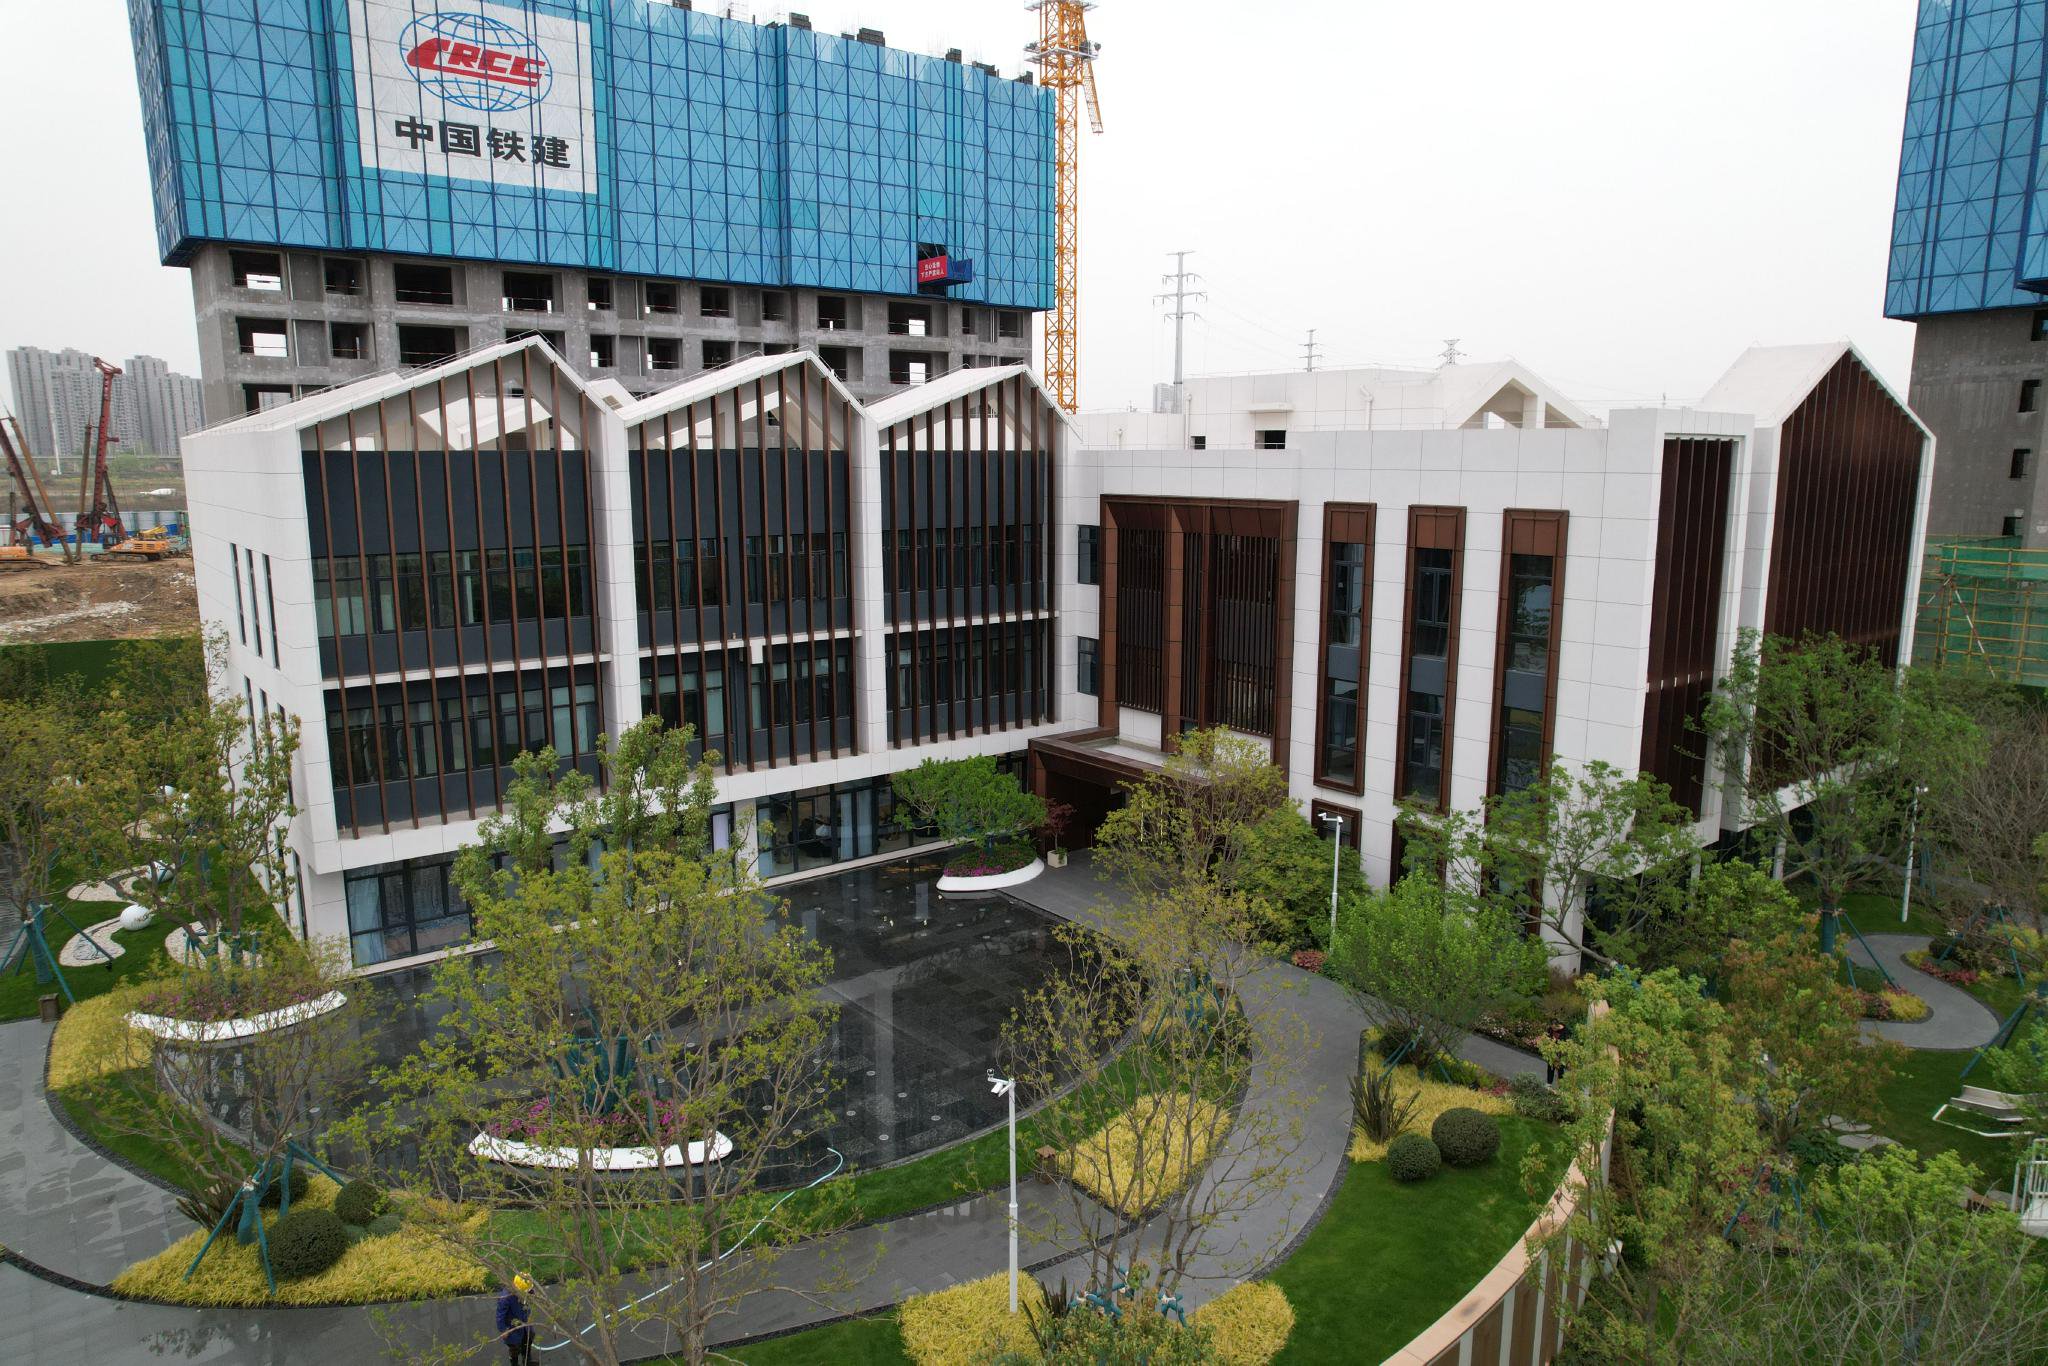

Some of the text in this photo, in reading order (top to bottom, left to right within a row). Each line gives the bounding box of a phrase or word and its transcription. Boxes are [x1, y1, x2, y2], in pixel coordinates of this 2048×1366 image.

[407, 38, 546, 87] CRCC
[395, 116, 571, 168] 中国铁建
